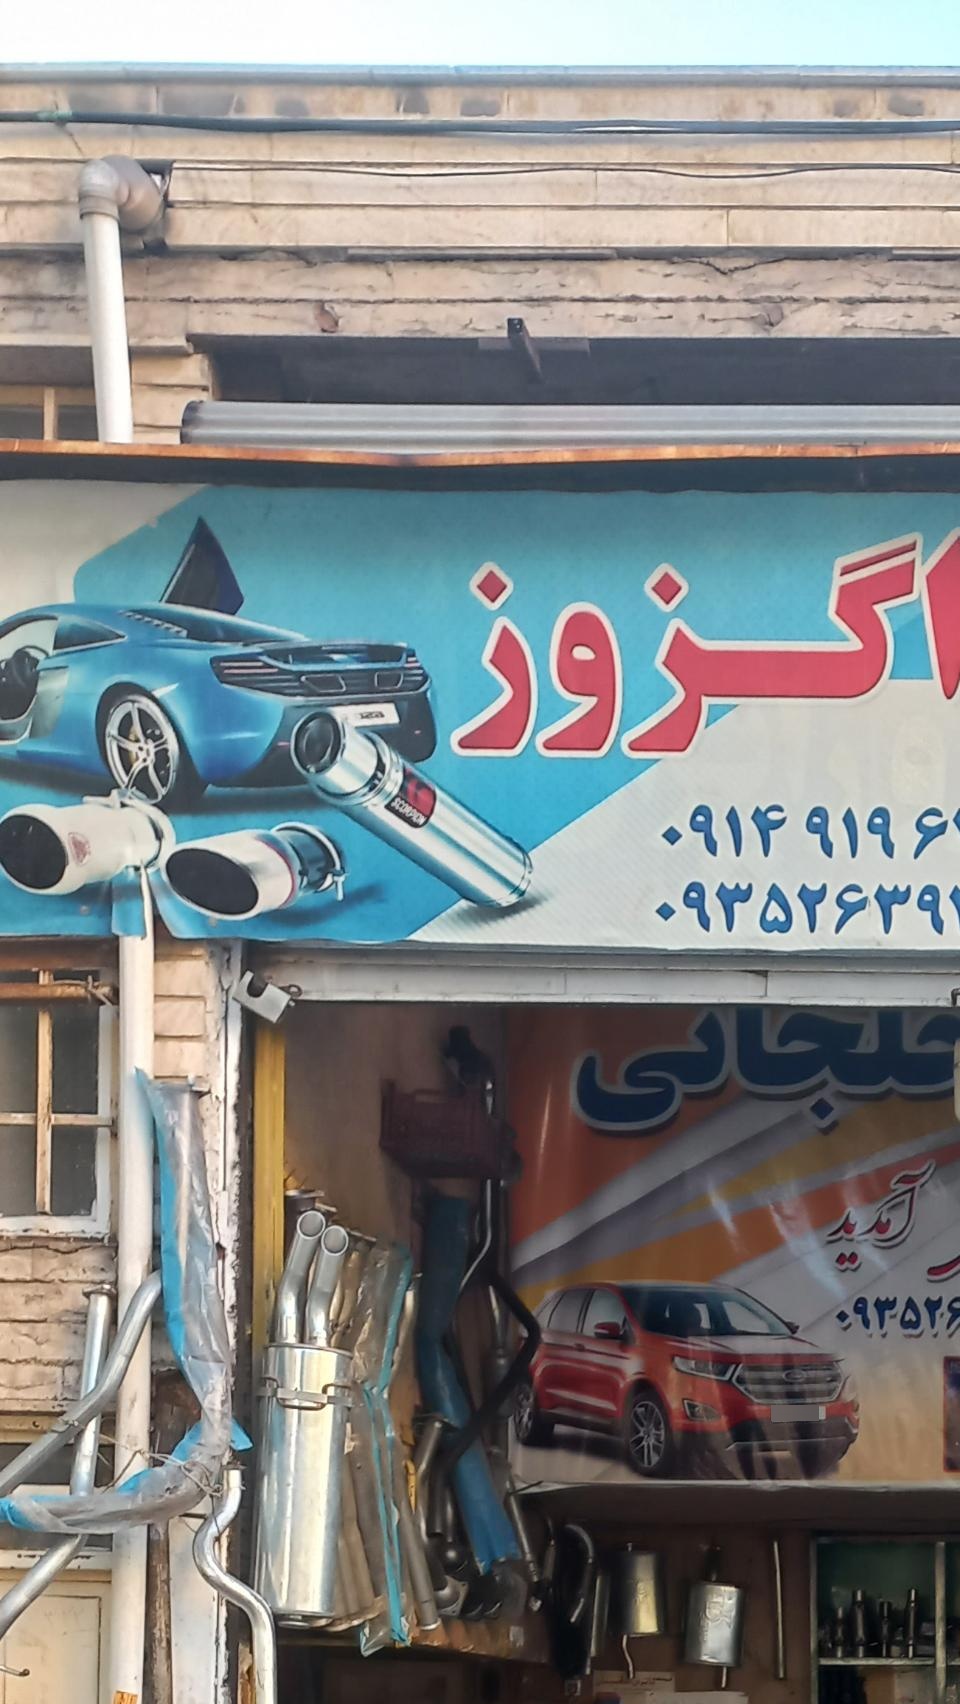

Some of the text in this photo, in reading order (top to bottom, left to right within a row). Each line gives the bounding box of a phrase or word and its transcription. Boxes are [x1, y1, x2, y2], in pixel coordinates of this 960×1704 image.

[661, 803, 788, 858] ۰۹۱۴
[805, 805, 895, 860] ۹۱۹
[825, 1158, 936, 1272] آمدید
